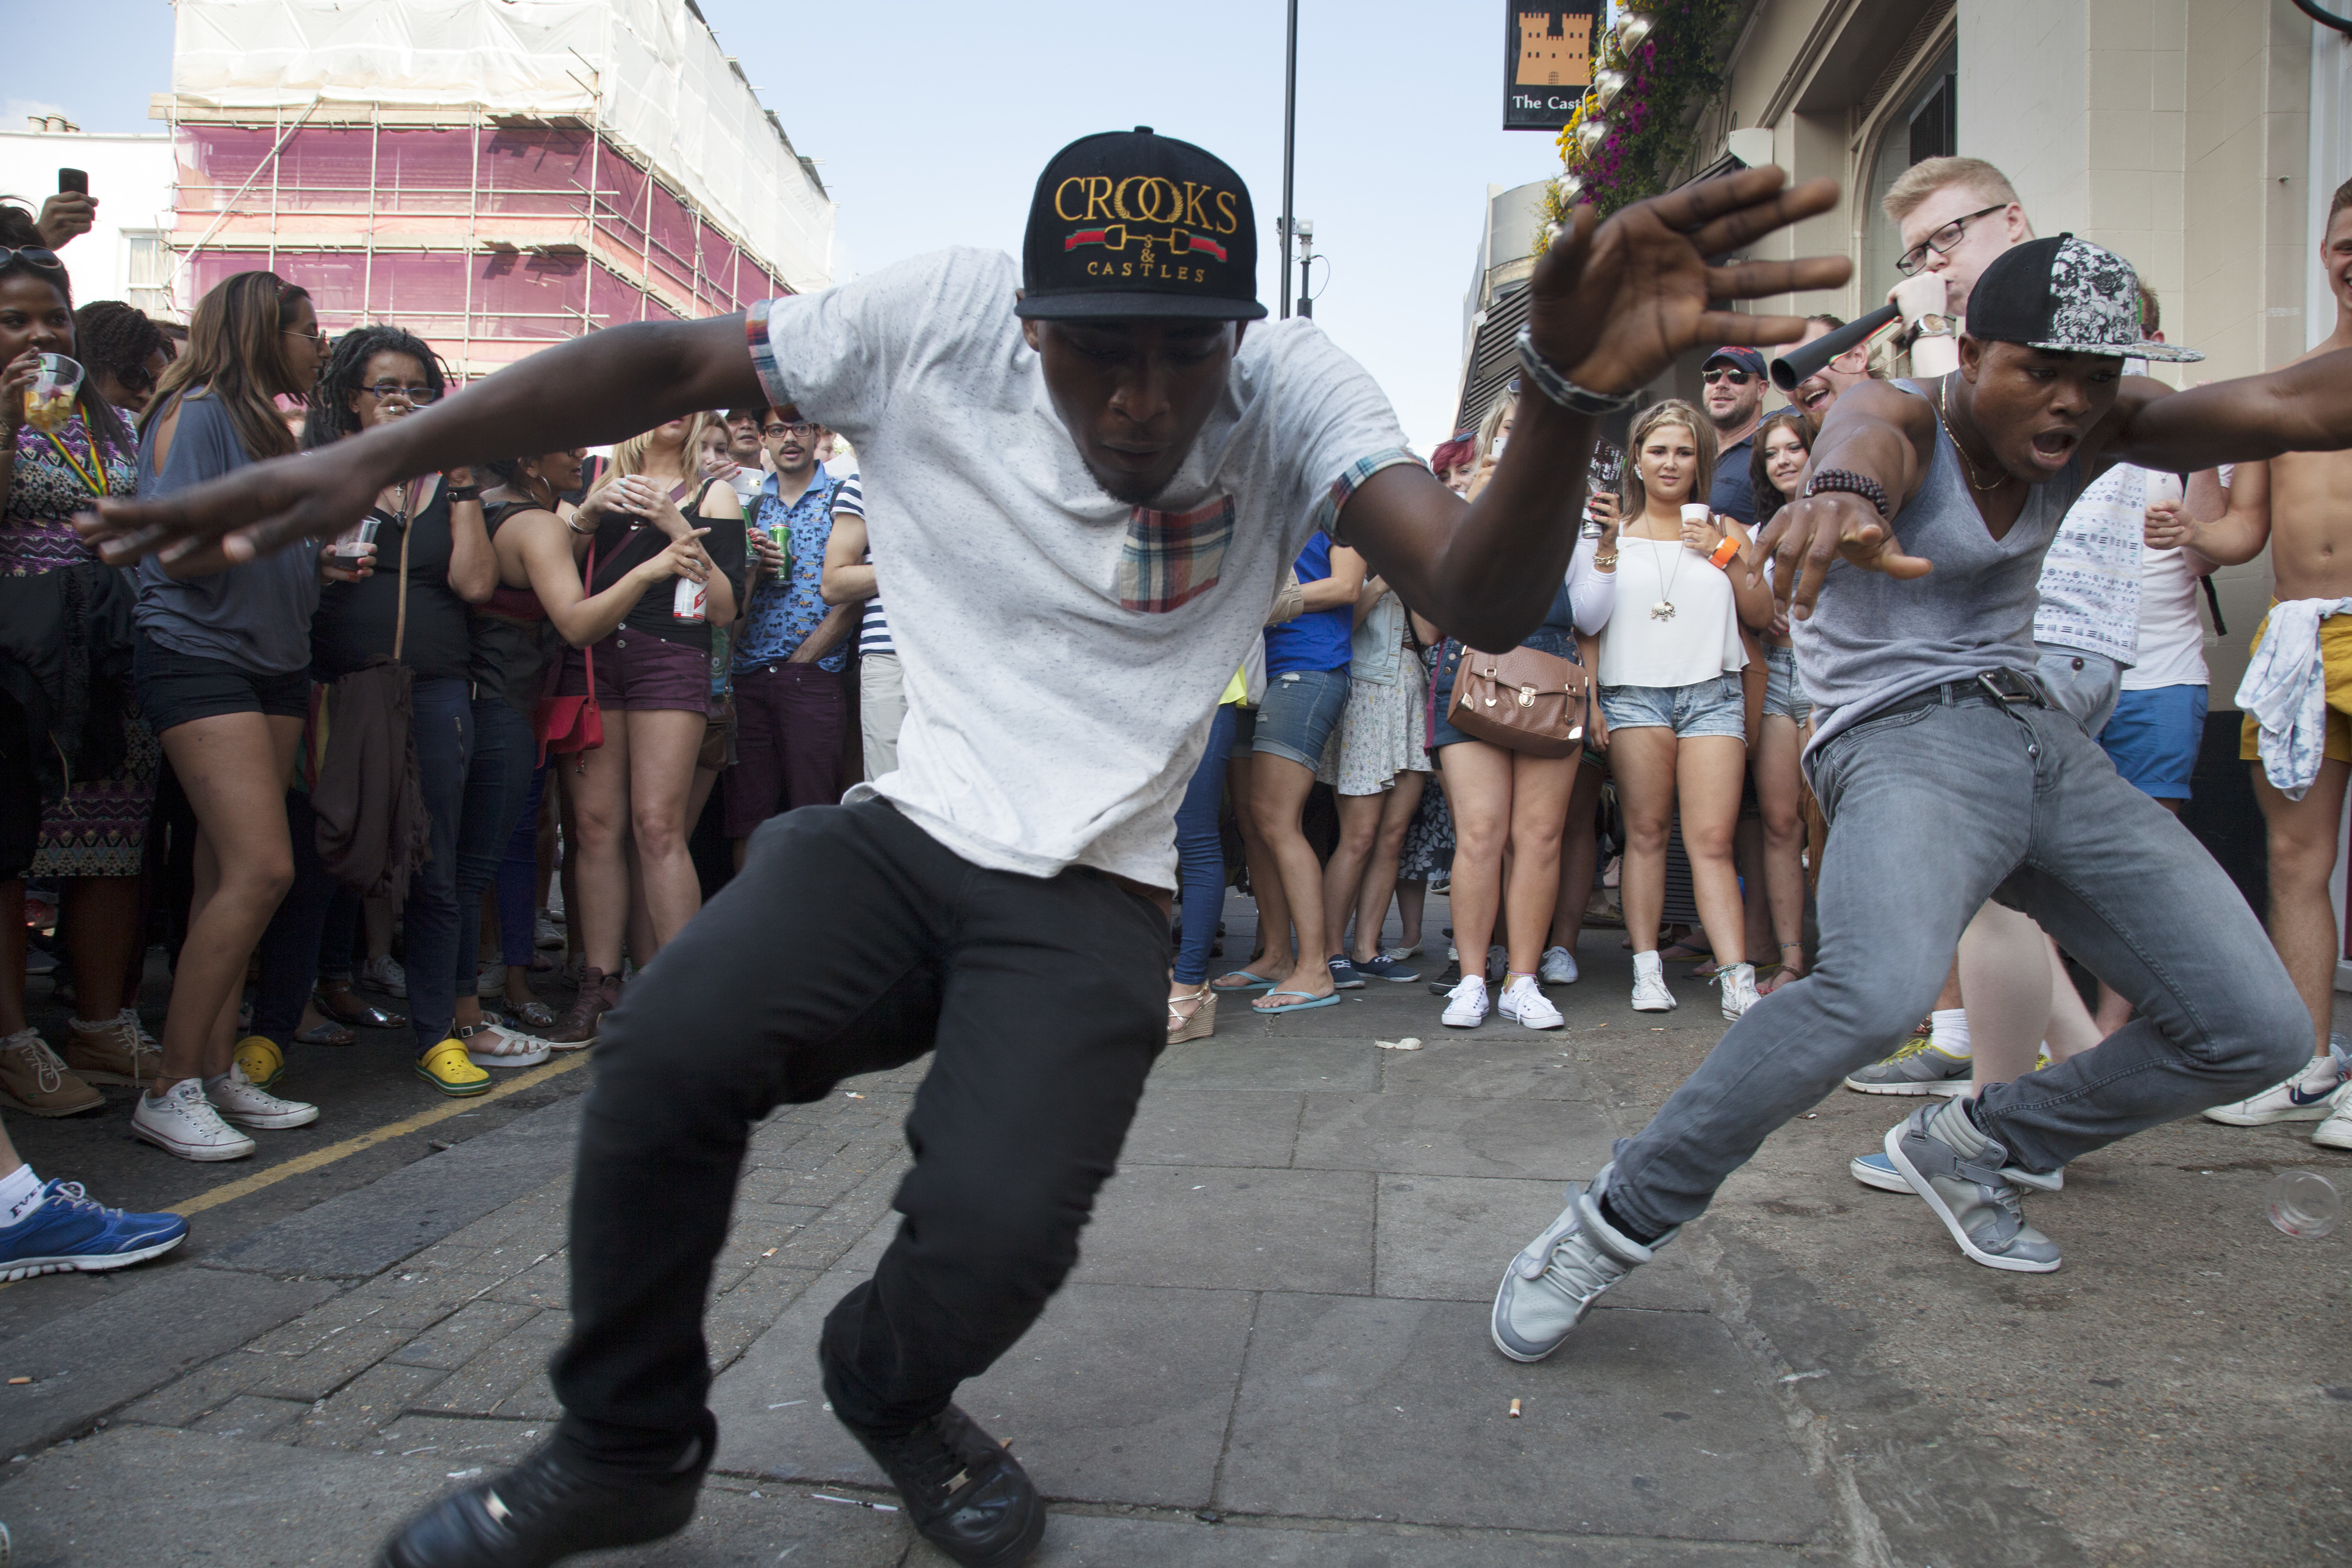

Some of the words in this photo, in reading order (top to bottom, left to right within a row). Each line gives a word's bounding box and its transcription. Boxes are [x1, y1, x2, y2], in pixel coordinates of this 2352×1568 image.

[1512, 95, 1542, 109] The
[1055, 176, 1237, 234] CROOKS
[1140, 248, 1155, 263] &
[1087, 262, 1205, 282] CASTLES
